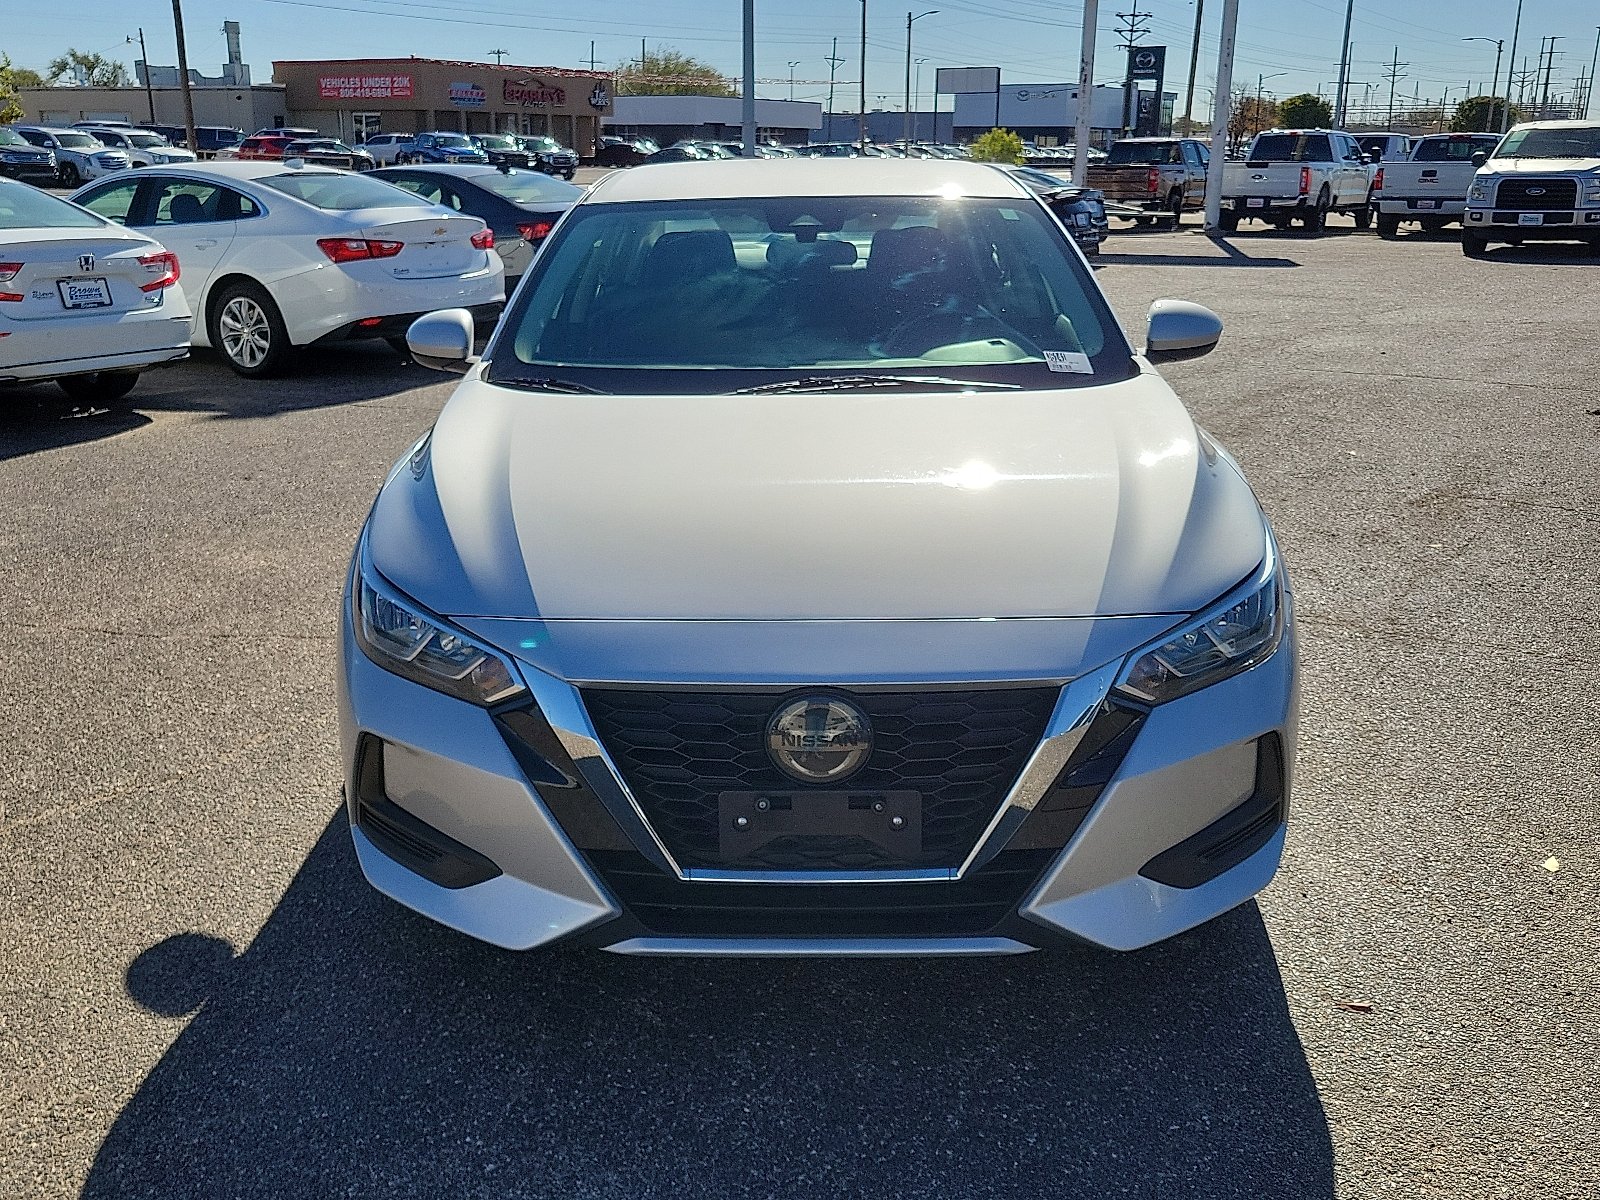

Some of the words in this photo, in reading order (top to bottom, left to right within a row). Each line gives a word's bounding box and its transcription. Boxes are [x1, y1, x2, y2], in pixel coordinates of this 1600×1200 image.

[320, 78, 361, 88] VEHICLES
[361, 77, 392, 88] UNDER
[392, 76, 410, 87] 20K
[68, 286, 101, 297] Brown
[782, 733, 859, 747] NISSAN
